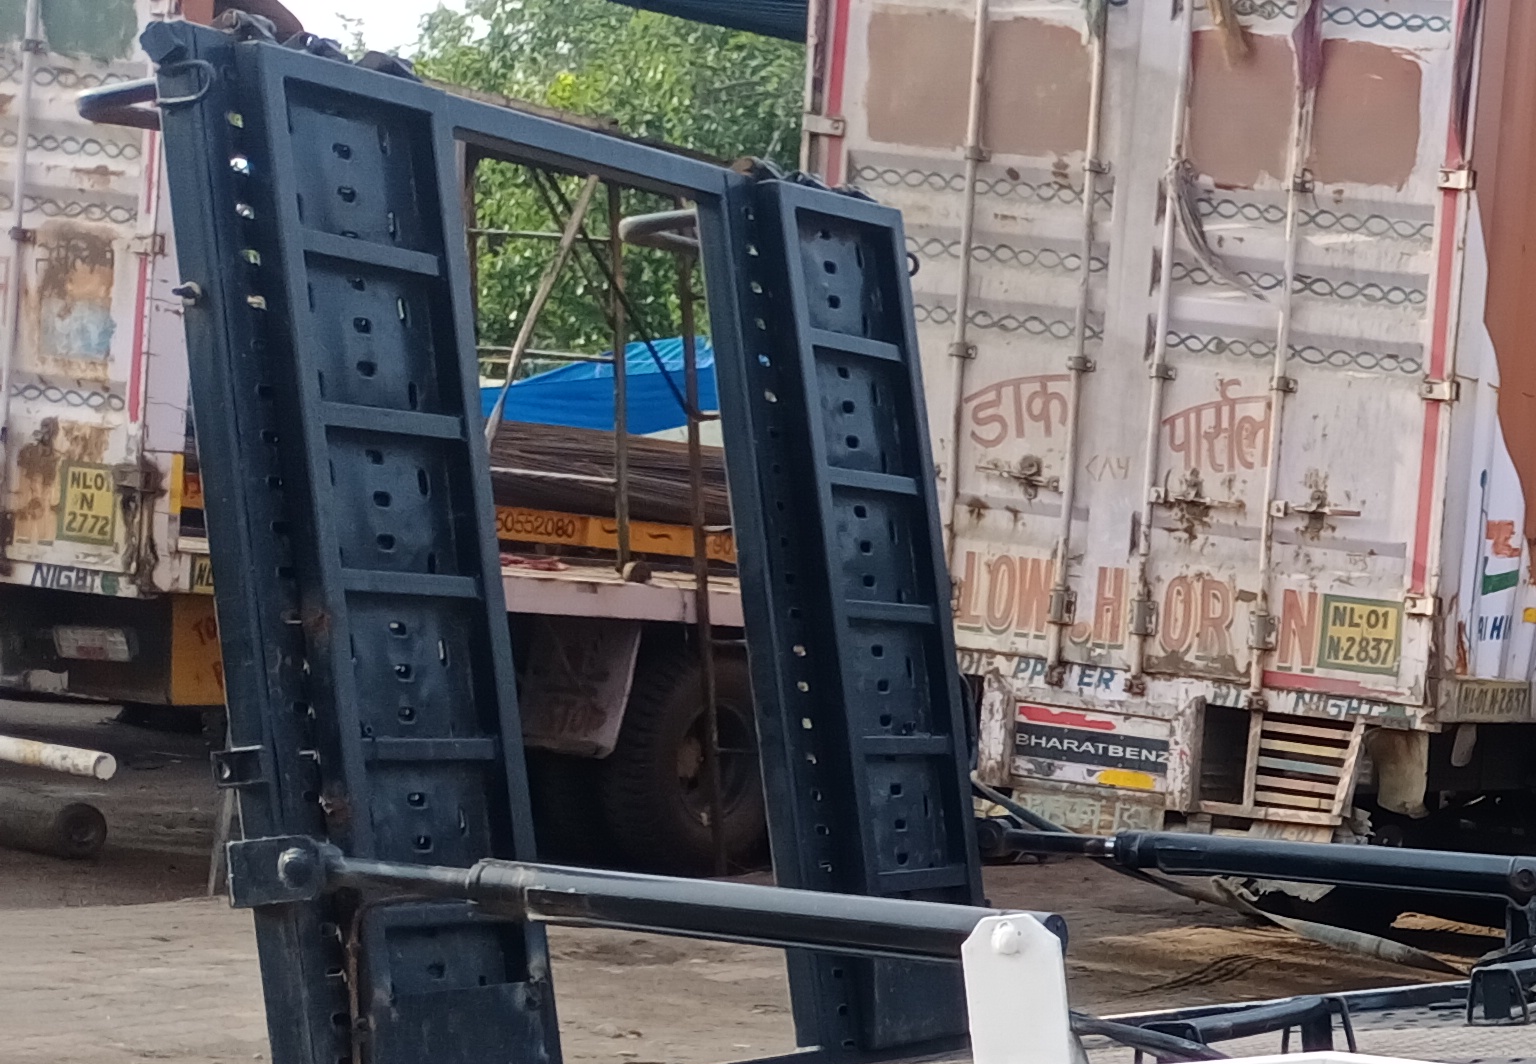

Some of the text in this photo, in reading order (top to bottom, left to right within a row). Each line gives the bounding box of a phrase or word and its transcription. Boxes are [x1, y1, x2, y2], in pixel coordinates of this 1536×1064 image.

[963, 374, 1071, 449] डाक
[79, 492, 95, 511] N
[65, 511, 110, 536] 2772
[1015, 732, 1171, 764] BHARATBENZ
